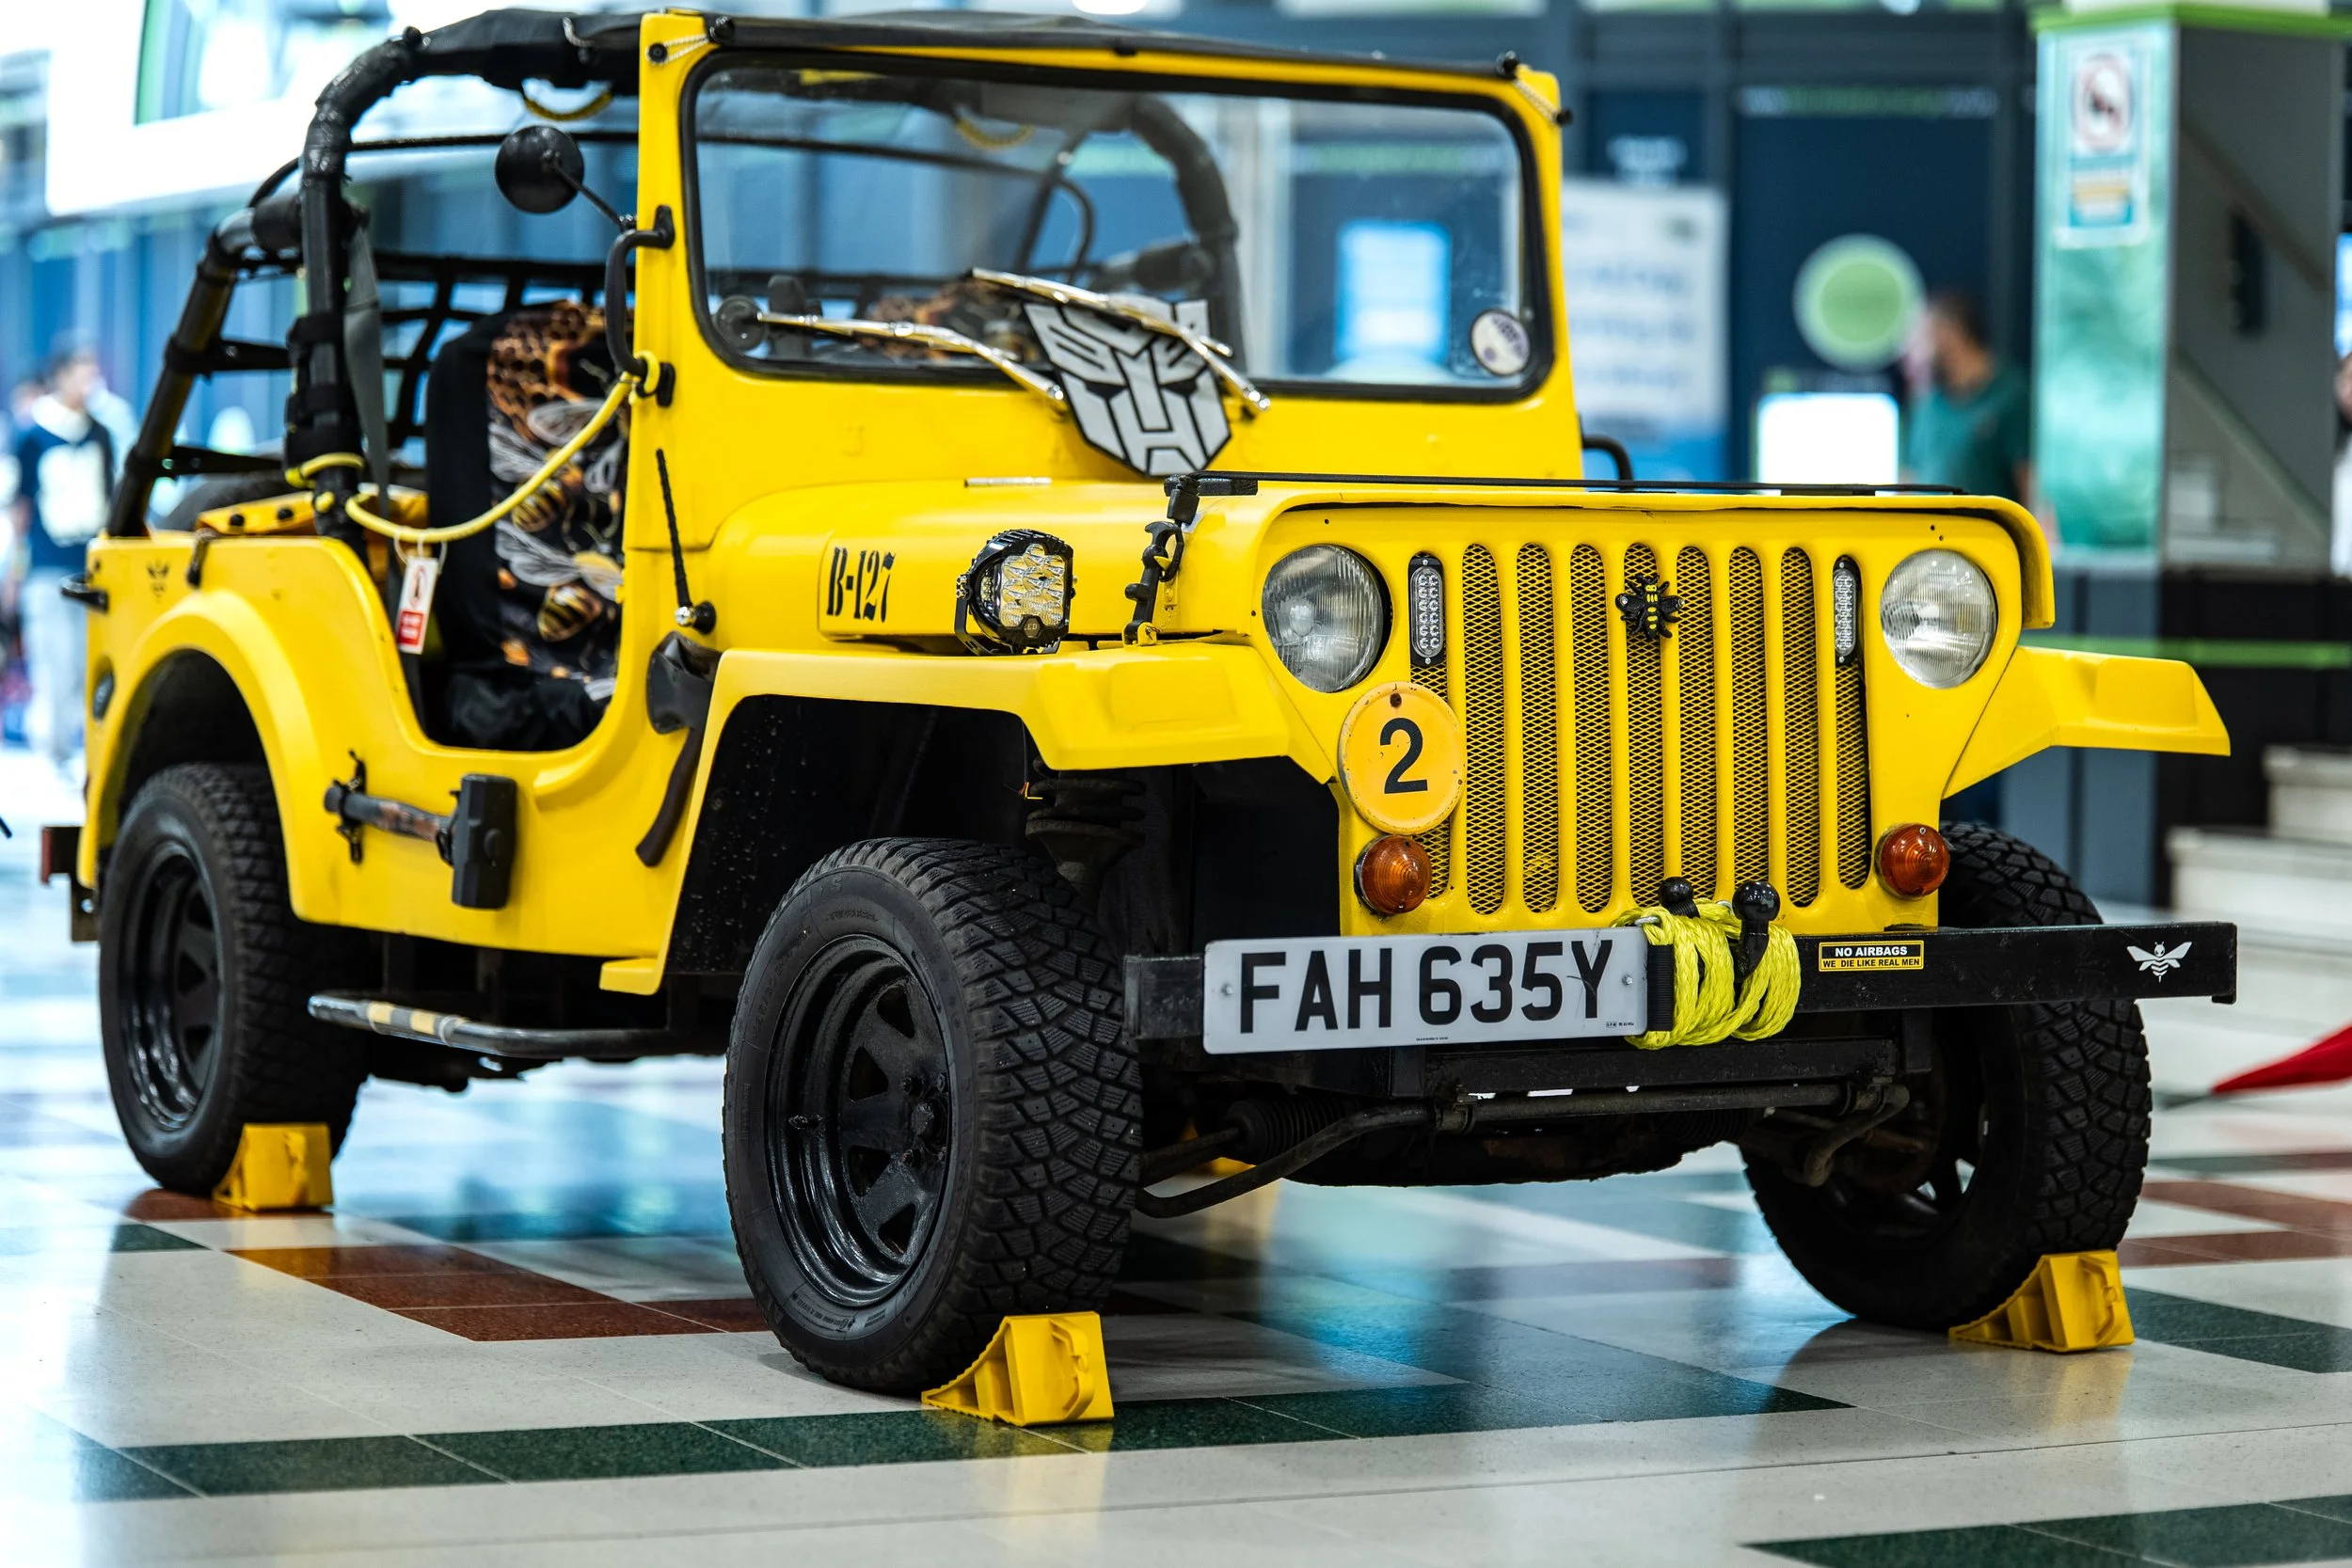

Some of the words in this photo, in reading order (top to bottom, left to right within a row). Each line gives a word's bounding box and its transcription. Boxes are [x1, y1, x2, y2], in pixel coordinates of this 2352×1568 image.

[826, 546, 896, 624] B-127
[1380, 718, 1428, 794] 2
[1240, 947, 1392, 1034] FAH
[1418, 939, 1613, 1026] 635Y
[1835, 947, 1852, 957] NO
[1855, 946, 1908, 957] AIRBAGS
